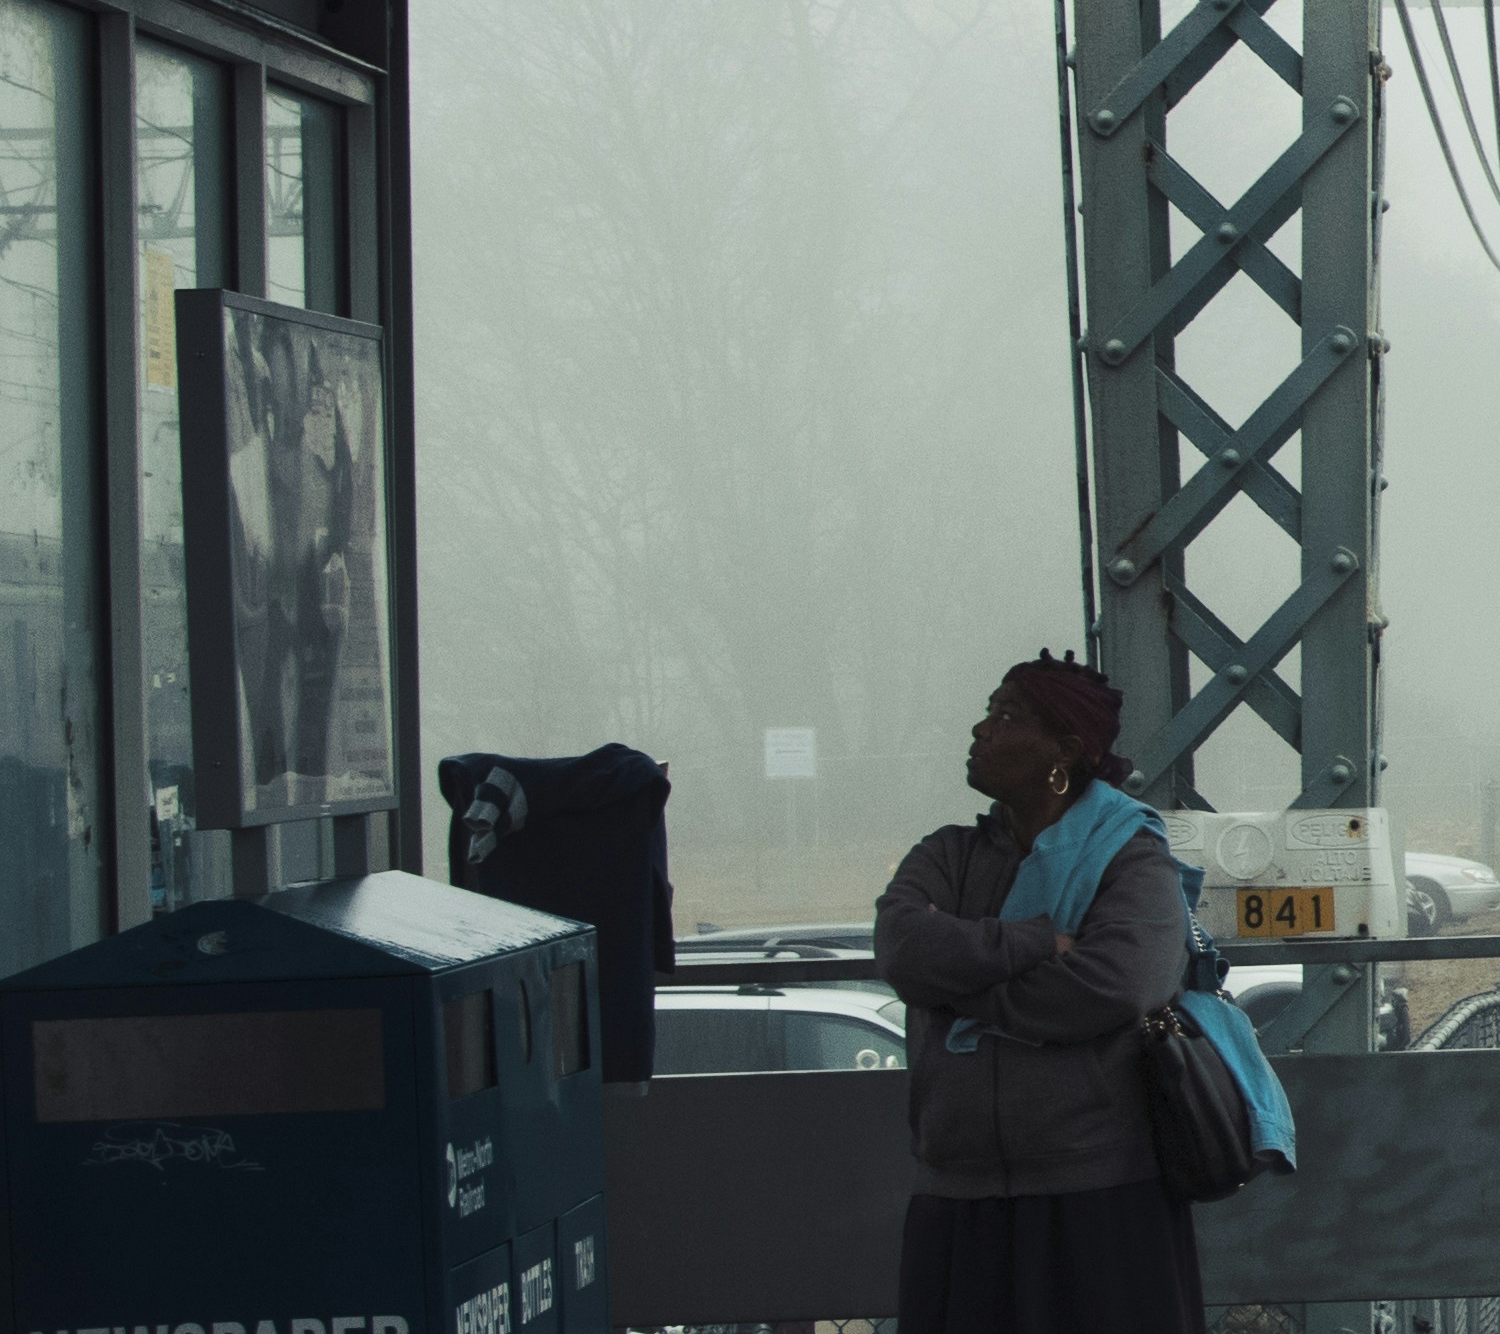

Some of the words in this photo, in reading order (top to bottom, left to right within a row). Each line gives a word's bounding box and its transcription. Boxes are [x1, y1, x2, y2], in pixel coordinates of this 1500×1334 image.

[1244, 894, 1322, 929] 841
[574, 1235, 596, 1290] TRASH
[520, 1257, 553, 1325] BOTTLES
